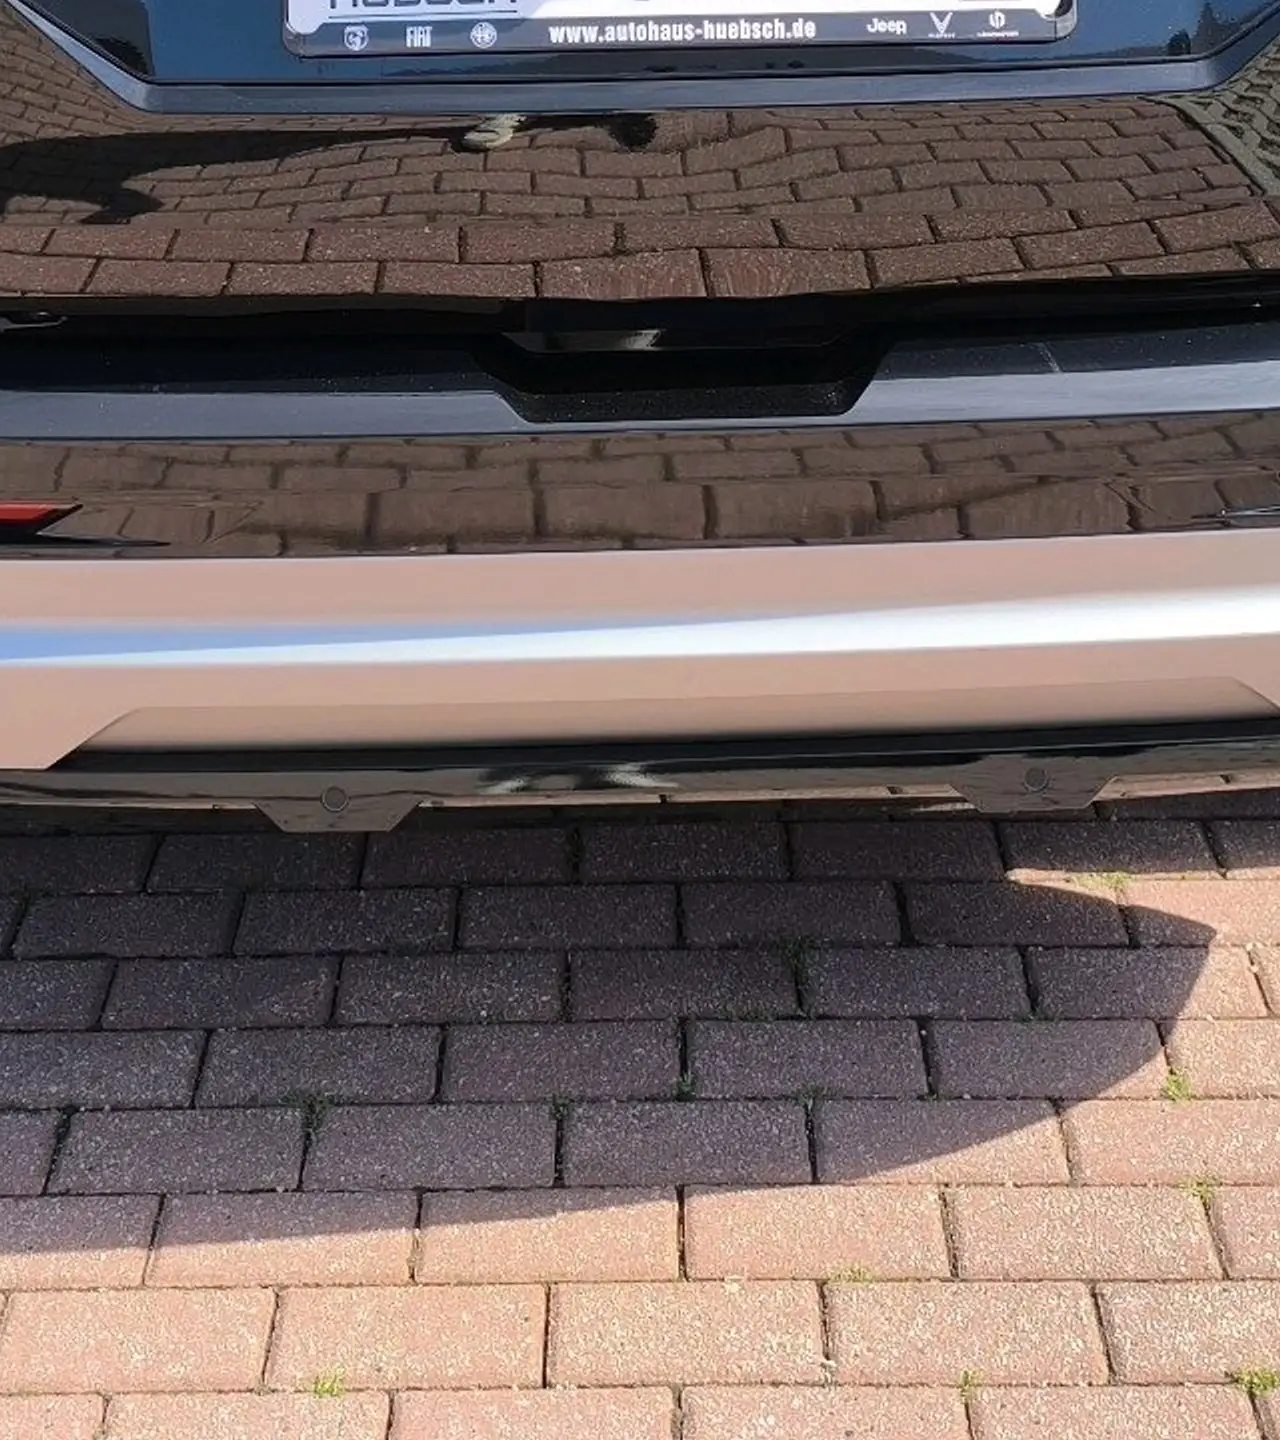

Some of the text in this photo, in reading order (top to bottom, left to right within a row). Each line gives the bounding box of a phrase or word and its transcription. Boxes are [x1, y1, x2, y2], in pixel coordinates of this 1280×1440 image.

[405, 25, 433, 48] FIAT
[548, 17, 817, 44] www.autohaus-huebsch.de
[866, 16, 908, 35] Jeep
